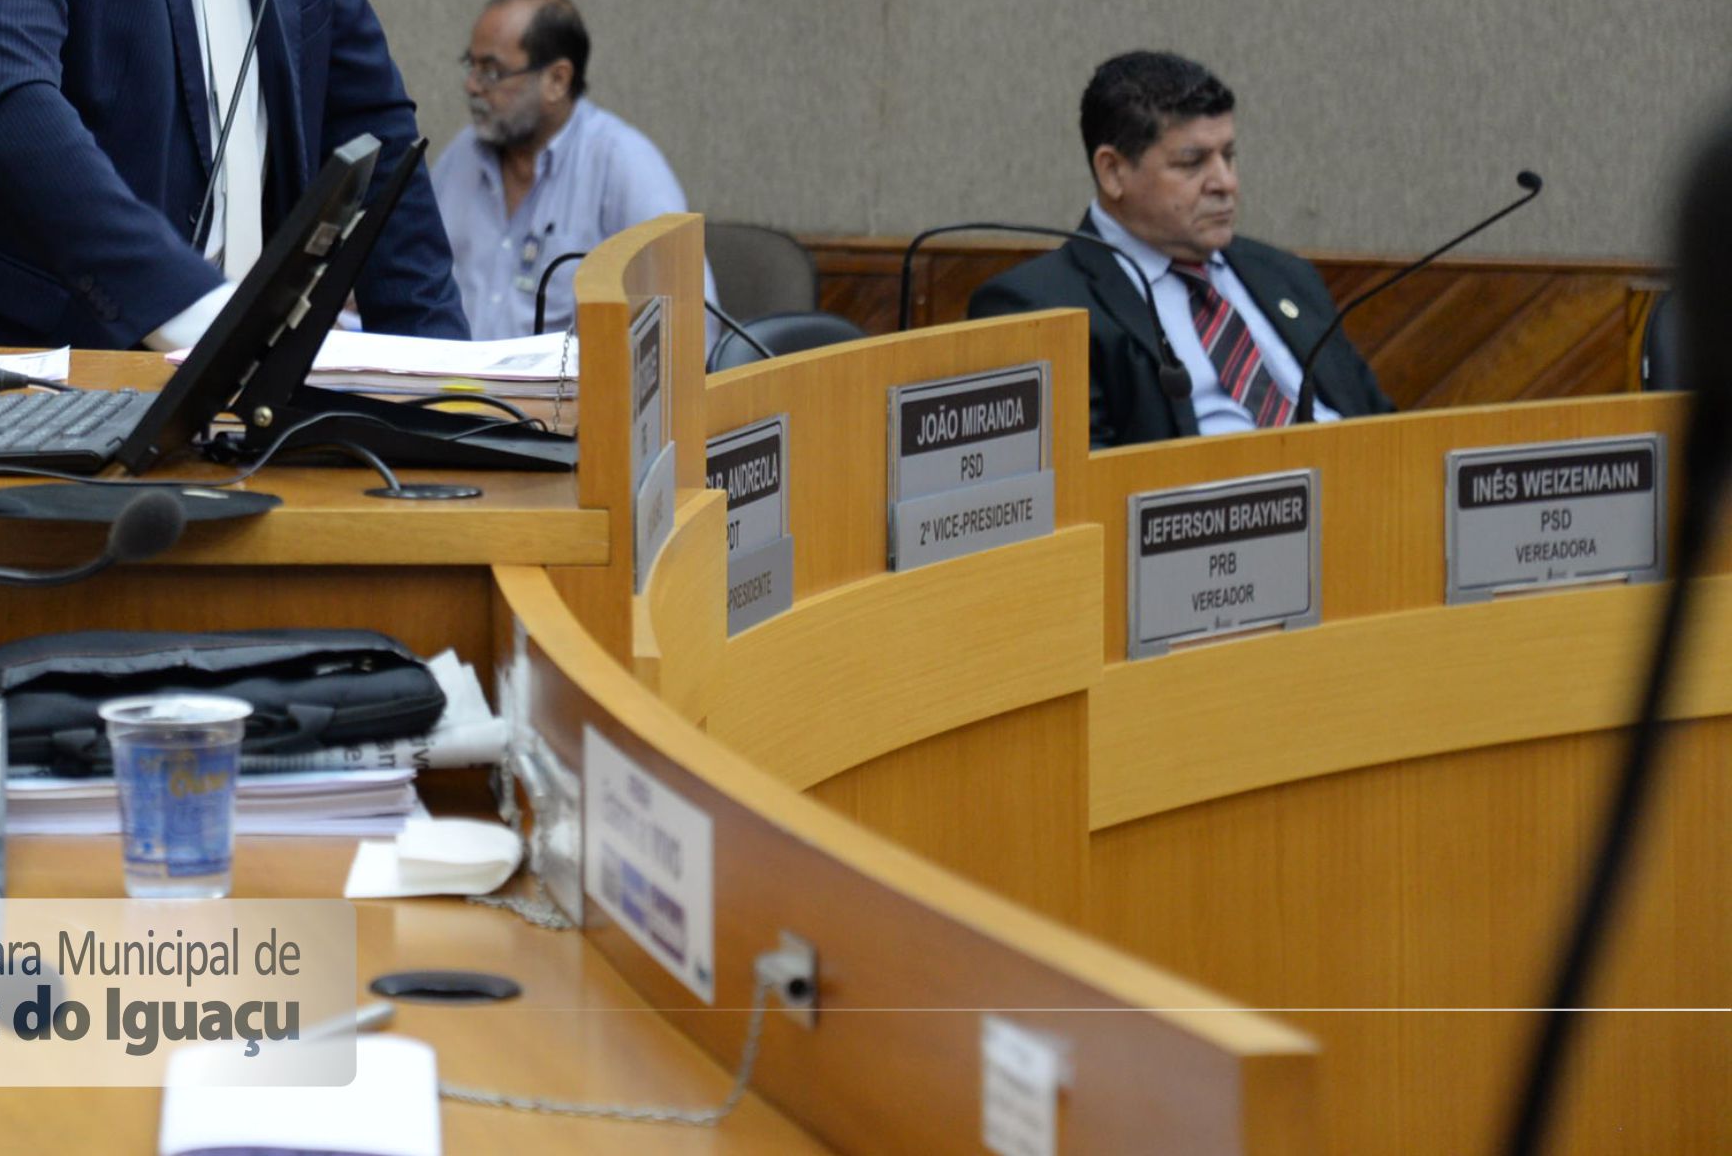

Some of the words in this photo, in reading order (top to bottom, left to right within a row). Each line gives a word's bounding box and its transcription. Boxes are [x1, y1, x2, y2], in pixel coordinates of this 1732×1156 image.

[917, 405, 959, 446] JOÃO
[961, 396, 1025, 437] MIRANDA
[728, 452, 779, 500] ANDREOLA
[960, 452, 984, 482] PSD
[1472, 466, 1518, 504] INÊS
[1522, 461, 1640, 498] WEIZEMANN
[933, 498, 1034, 542] VICE-PRESIDENTE
[1143, 508, 1226, 546] JEFERSON
[1229, 496, 1304, 533] BRAYNER
[1540, 508, 1572, 533] PSD
[1208, 552, 1237, 579] PRB
[1516, 538, 1597, 565] VEREADORA
[1191, 583, 1255, 613] VEREADOR
